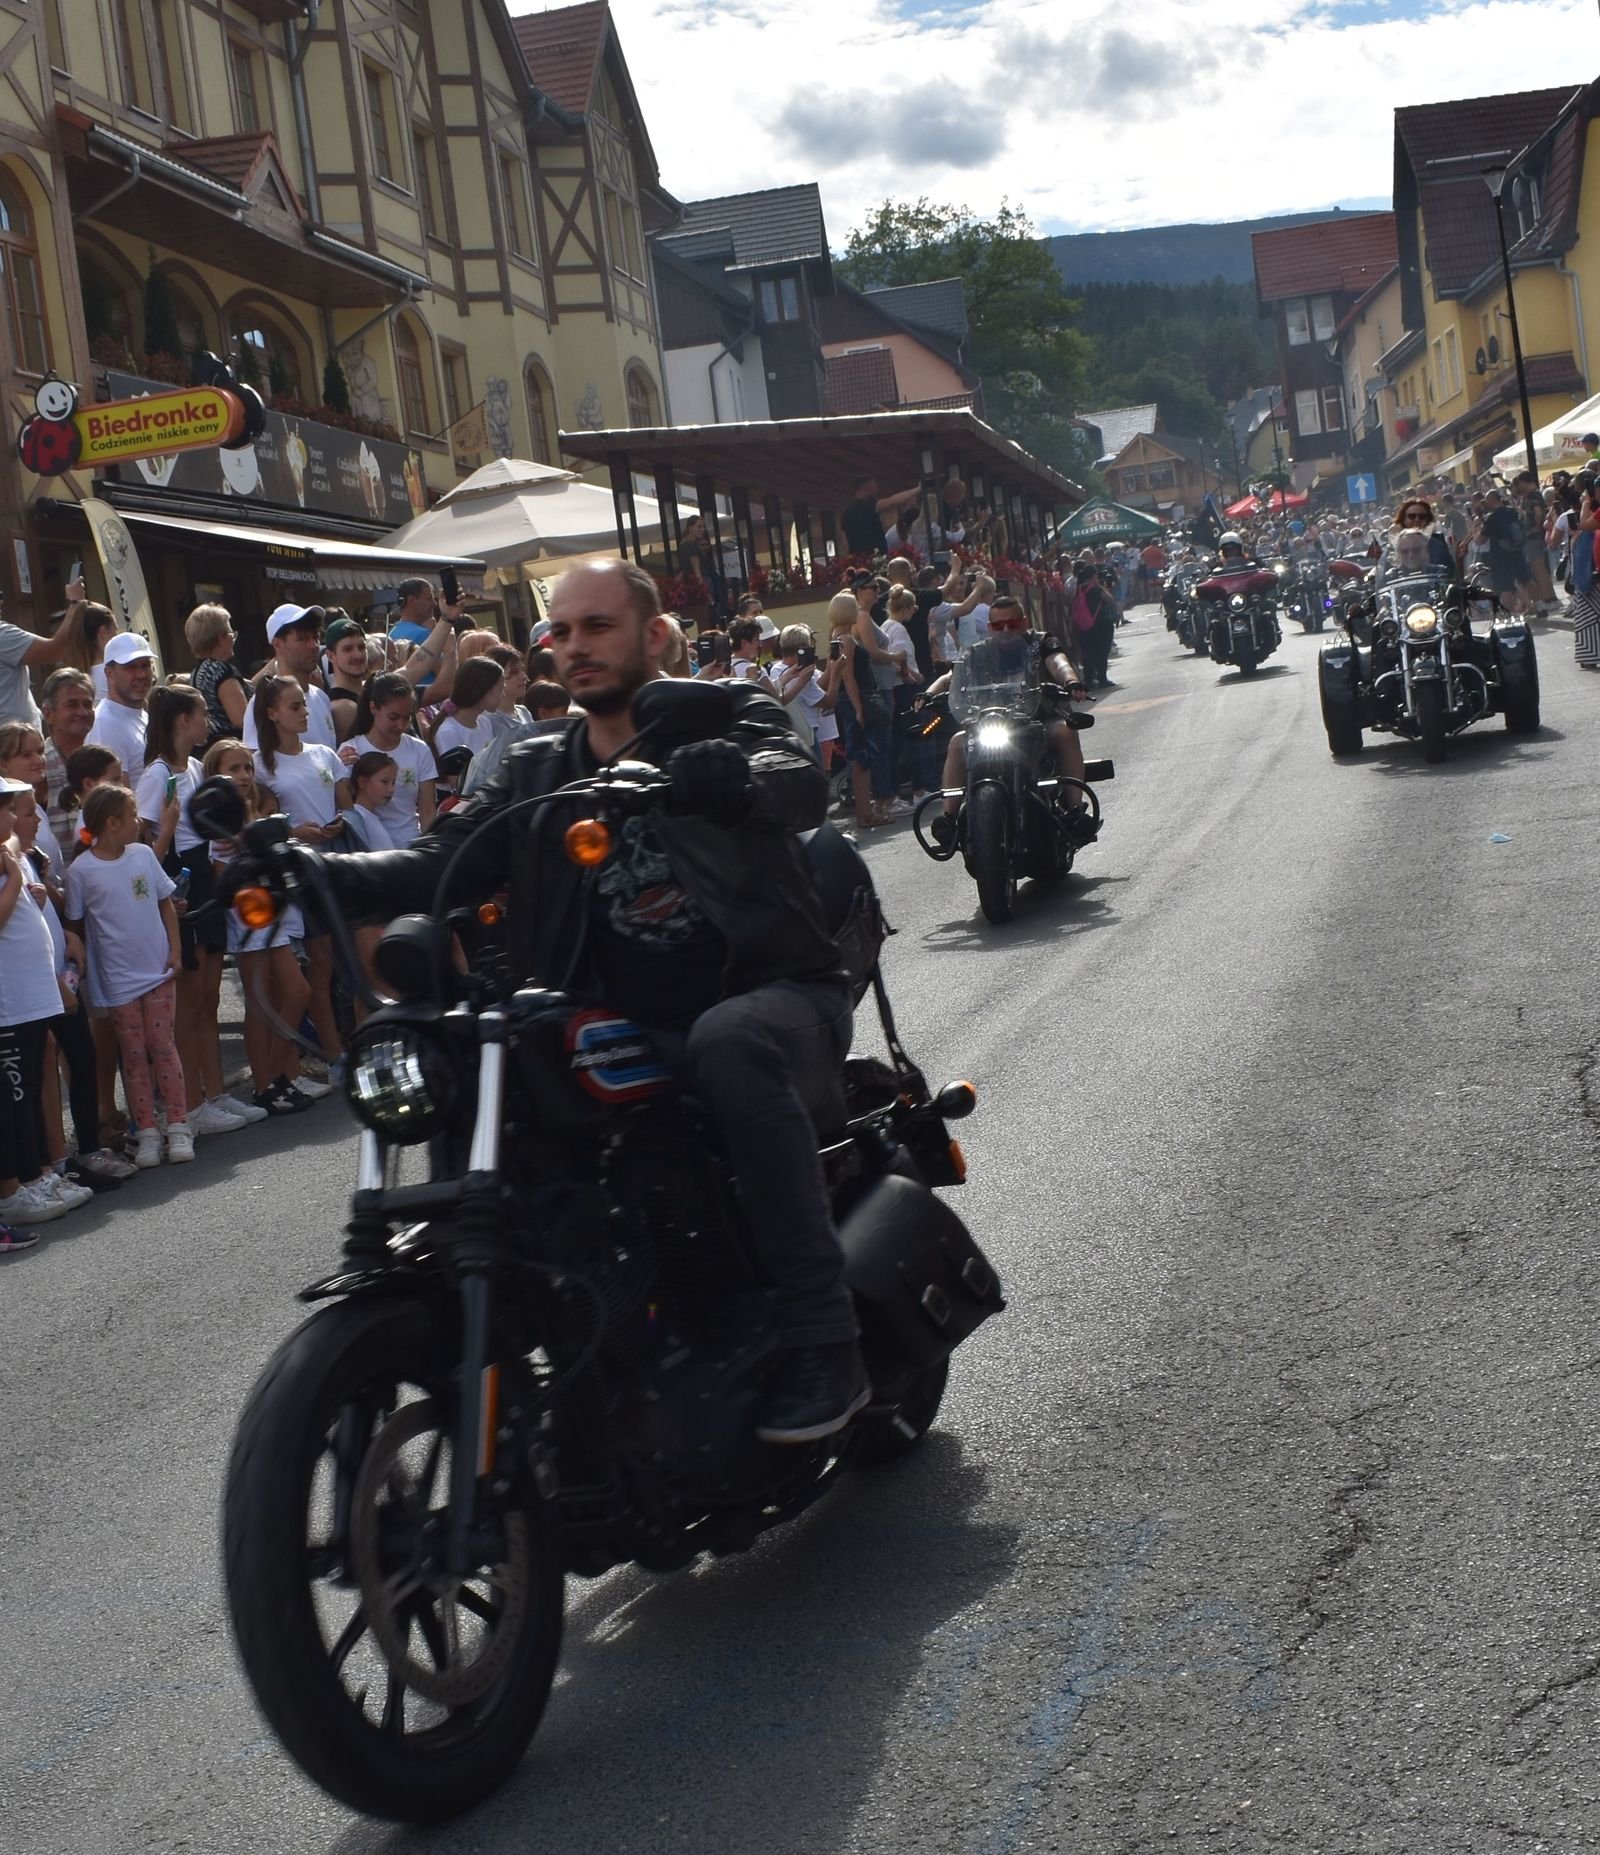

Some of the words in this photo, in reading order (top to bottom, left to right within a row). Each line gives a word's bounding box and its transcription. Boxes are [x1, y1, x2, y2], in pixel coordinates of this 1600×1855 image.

[87, 401, 219, 439] Biedronka
[90, 432, 153, 452] Codziennie
[157, 426, 190, 440] niskie
[193, 422, 220, 434] ceny
